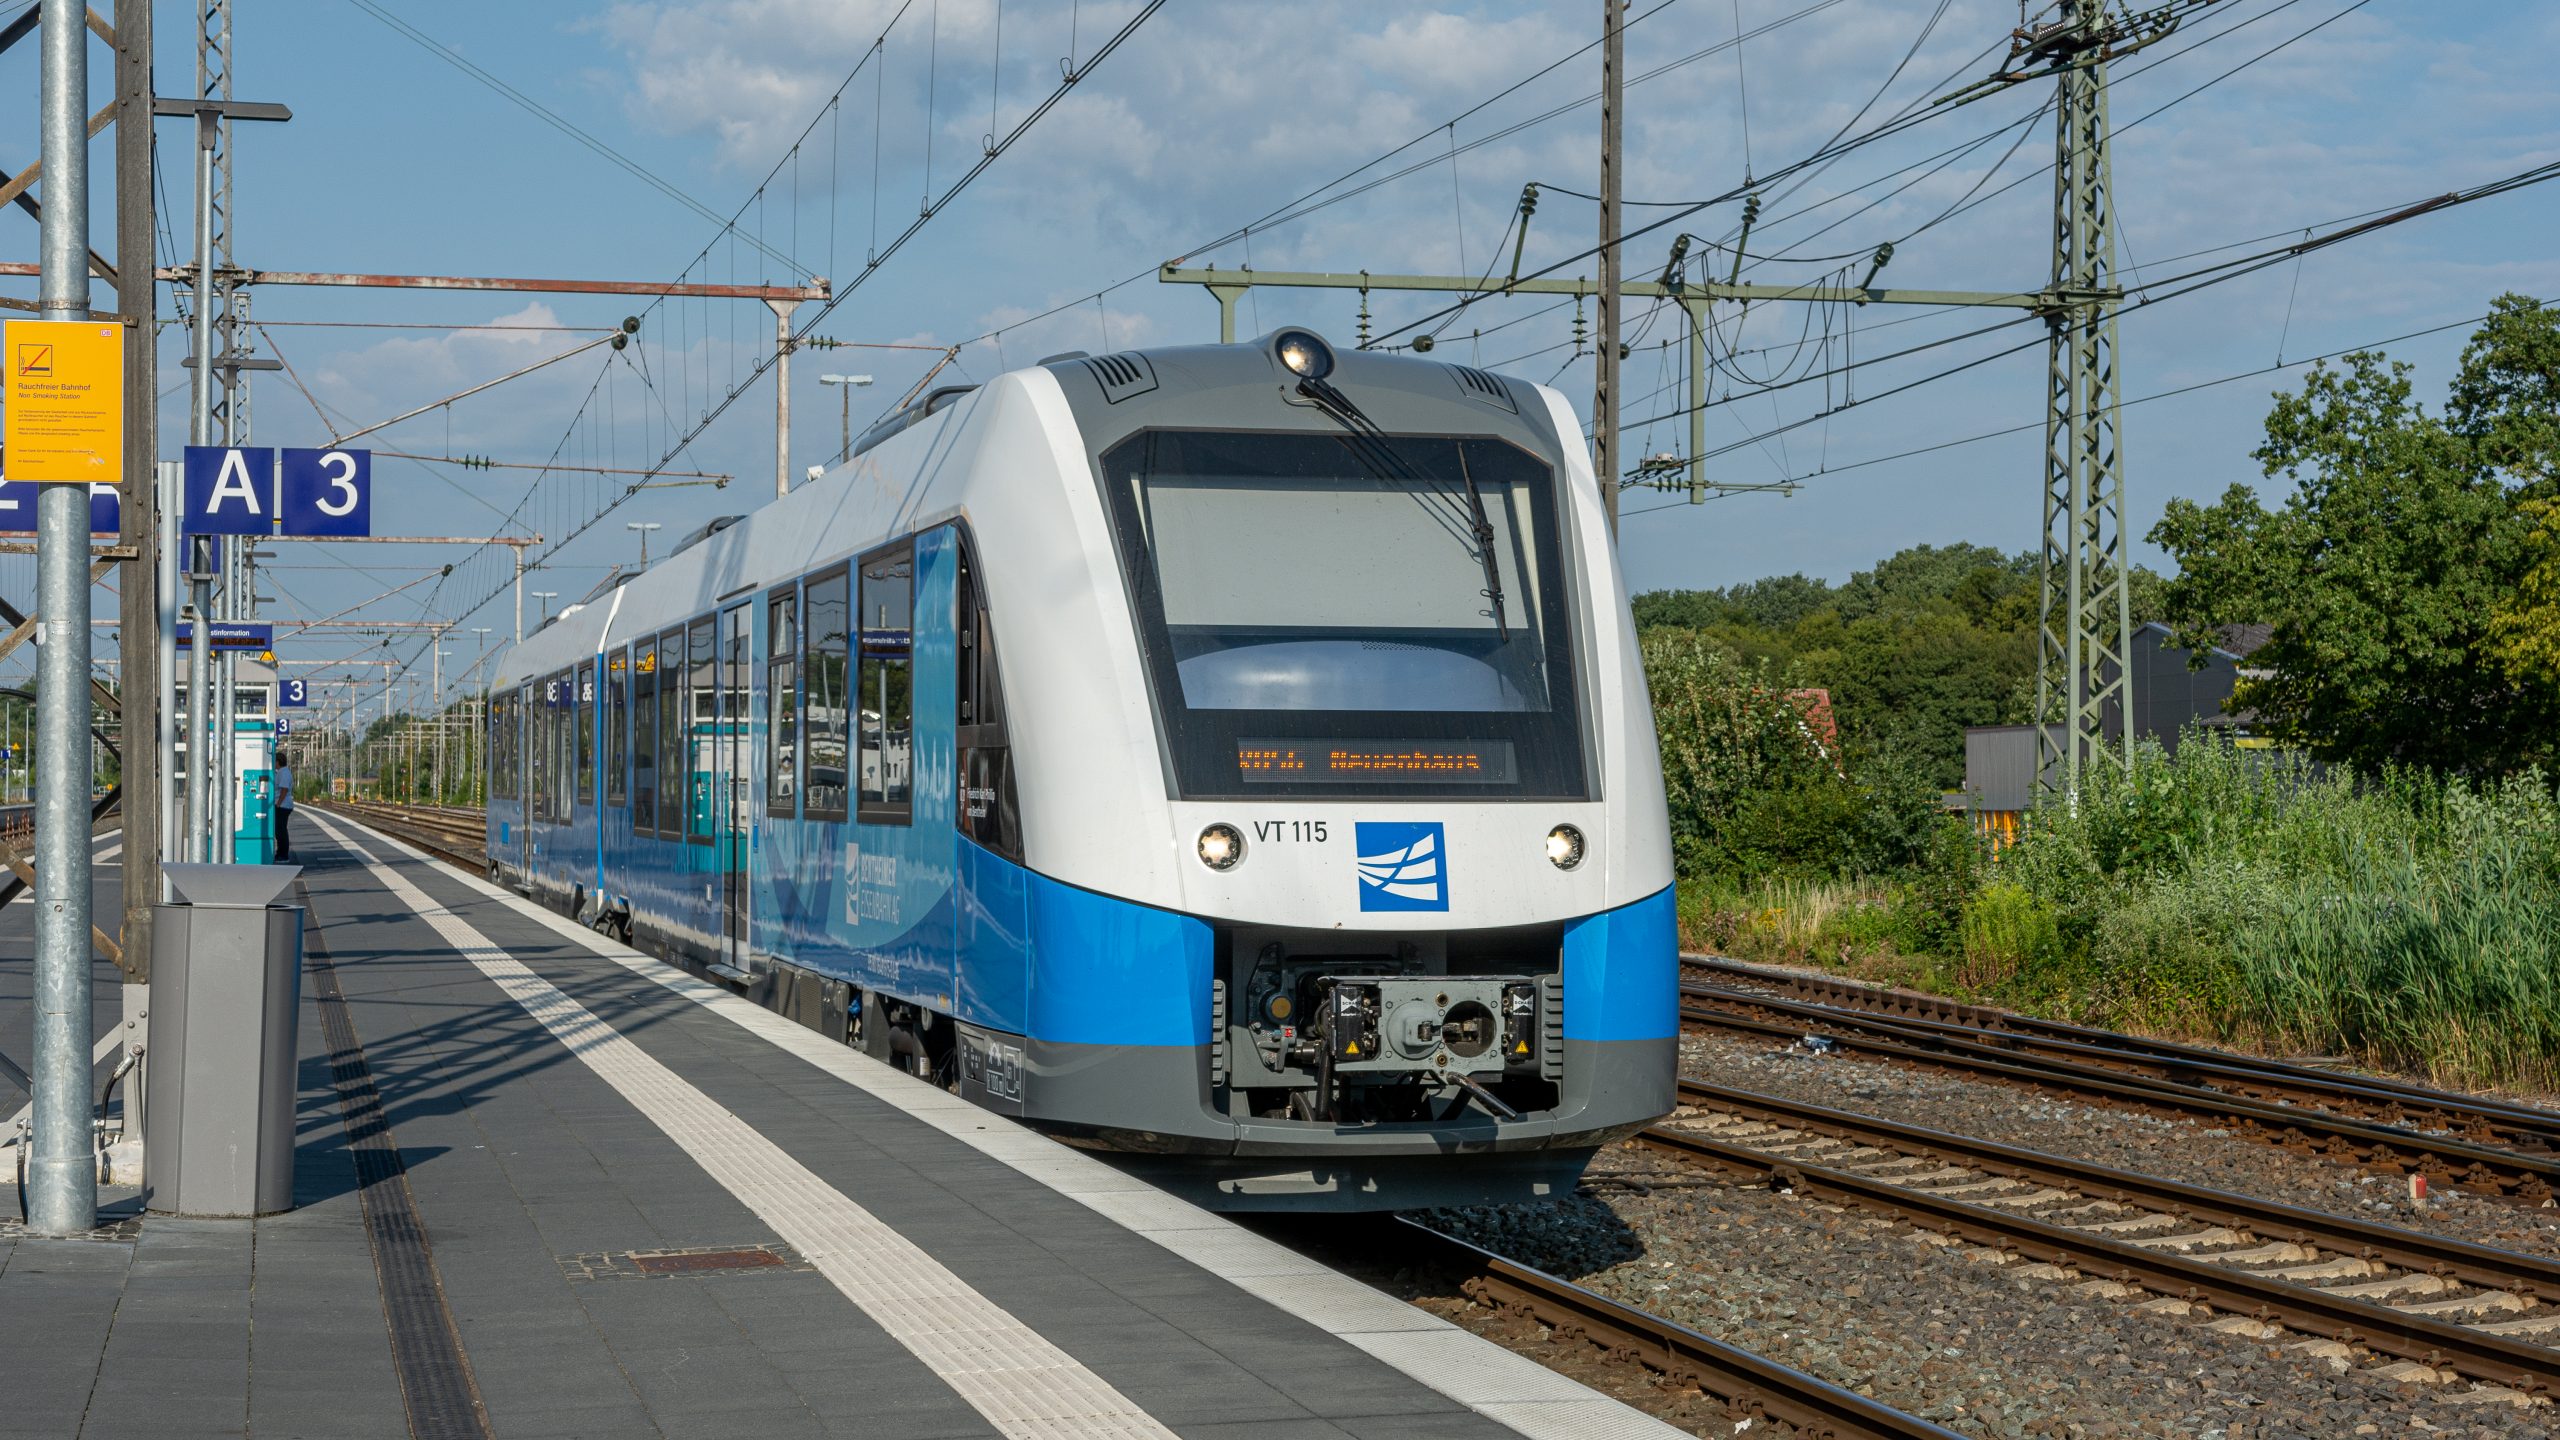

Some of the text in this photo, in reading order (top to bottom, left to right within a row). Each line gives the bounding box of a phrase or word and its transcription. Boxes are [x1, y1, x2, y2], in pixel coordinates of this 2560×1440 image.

[18, 382, 90, 391] Rauchfreier Bahnhof
[206, 449, 358, 516] A 3
[290, 681, 304, 702] 3
[279, 719, 288, 732] 3
[1329, 751, 1480, 769] Neuenhaus
[1253, 820, 1328, 842] VT 115
